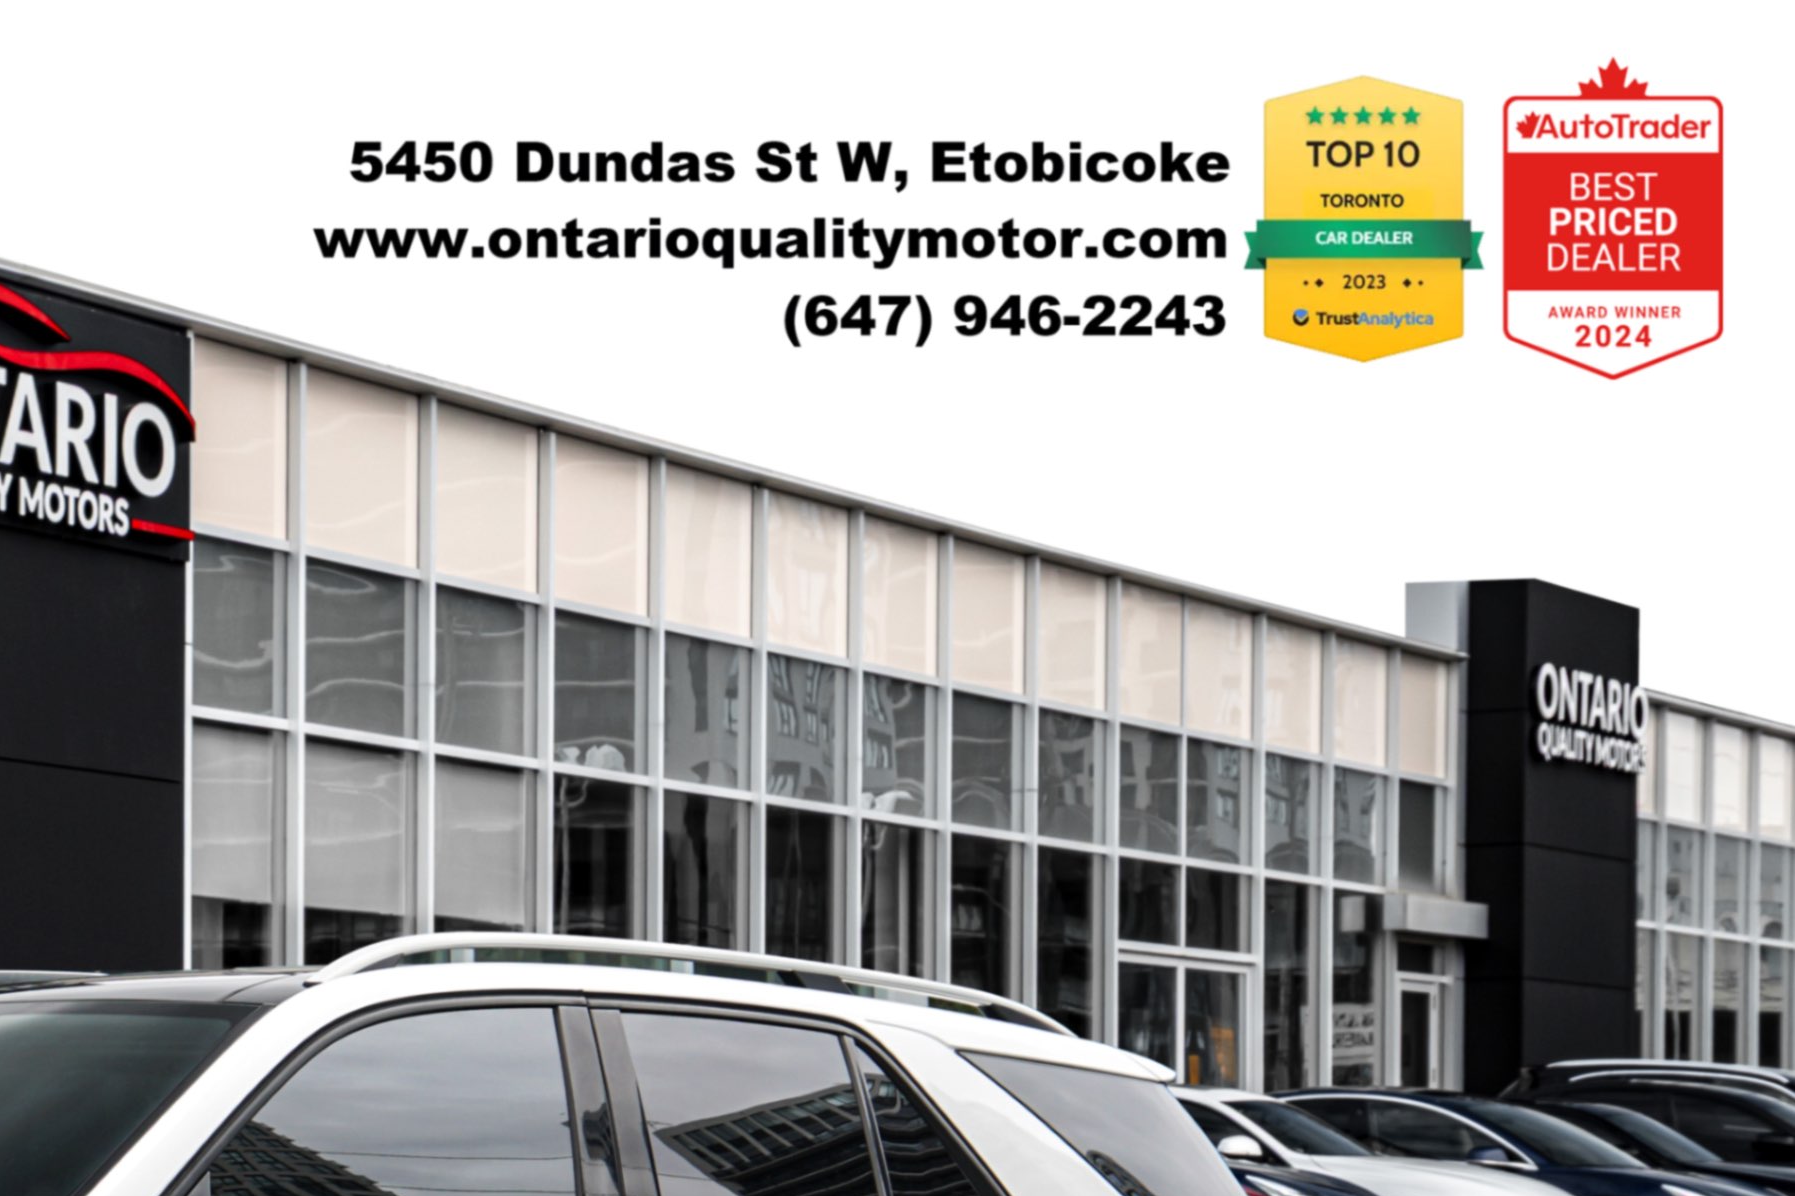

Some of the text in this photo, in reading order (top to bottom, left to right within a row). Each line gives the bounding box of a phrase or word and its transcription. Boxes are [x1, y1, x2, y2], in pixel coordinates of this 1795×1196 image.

[18, 476, 130, 536] MOTORS
[1537, 662, 1648, 740] ONTARIO
[1537, 722, 1646, 774] QUALITY MOTORS
